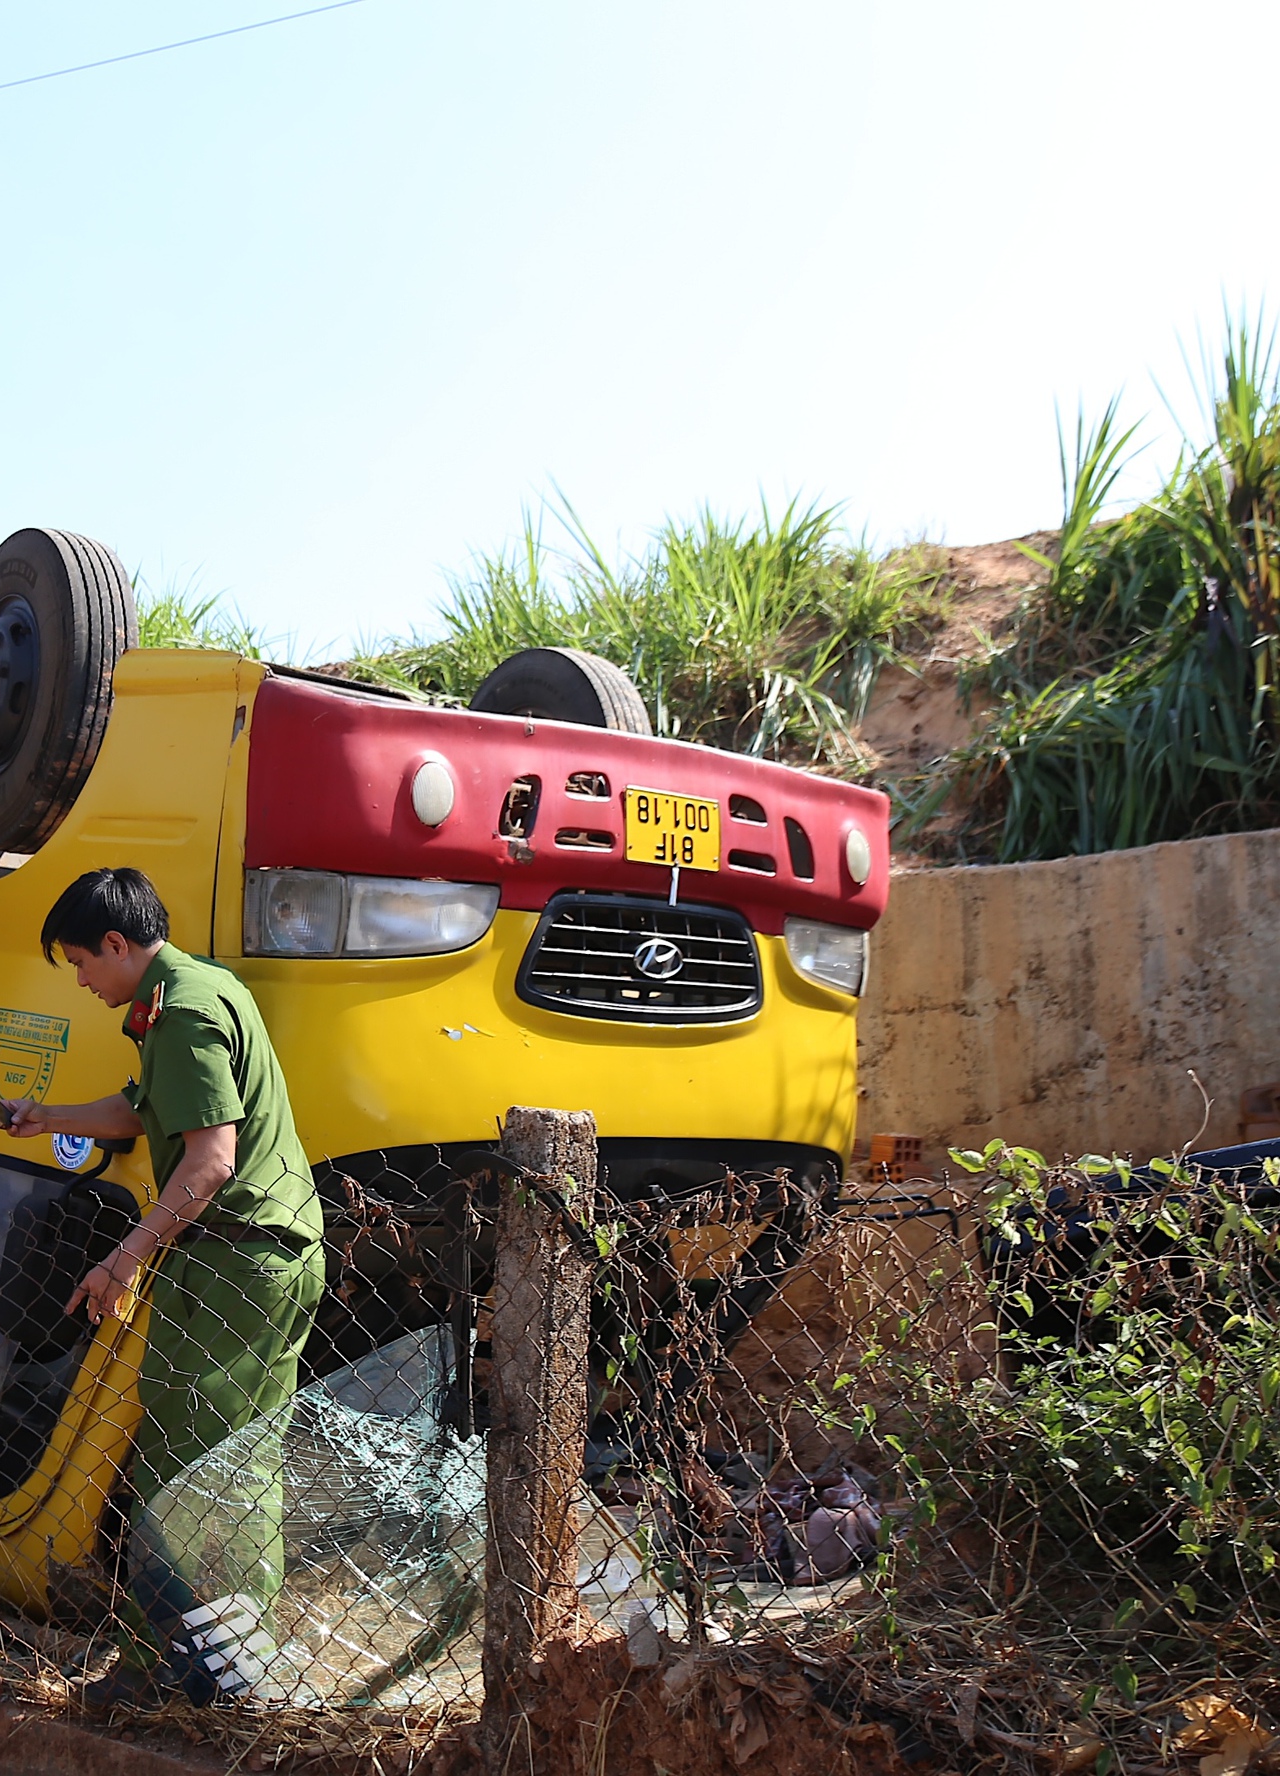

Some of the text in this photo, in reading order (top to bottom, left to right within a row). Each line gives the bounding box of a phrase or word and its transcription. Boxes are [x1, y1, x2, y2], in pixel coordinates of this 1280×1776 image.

[637, 795, 710, 833] 001.18
[654, 833, 694, 864] 81F
[4, 1071, 27, 1085] 29N
[35, 1062, 52, 1094] HTX
